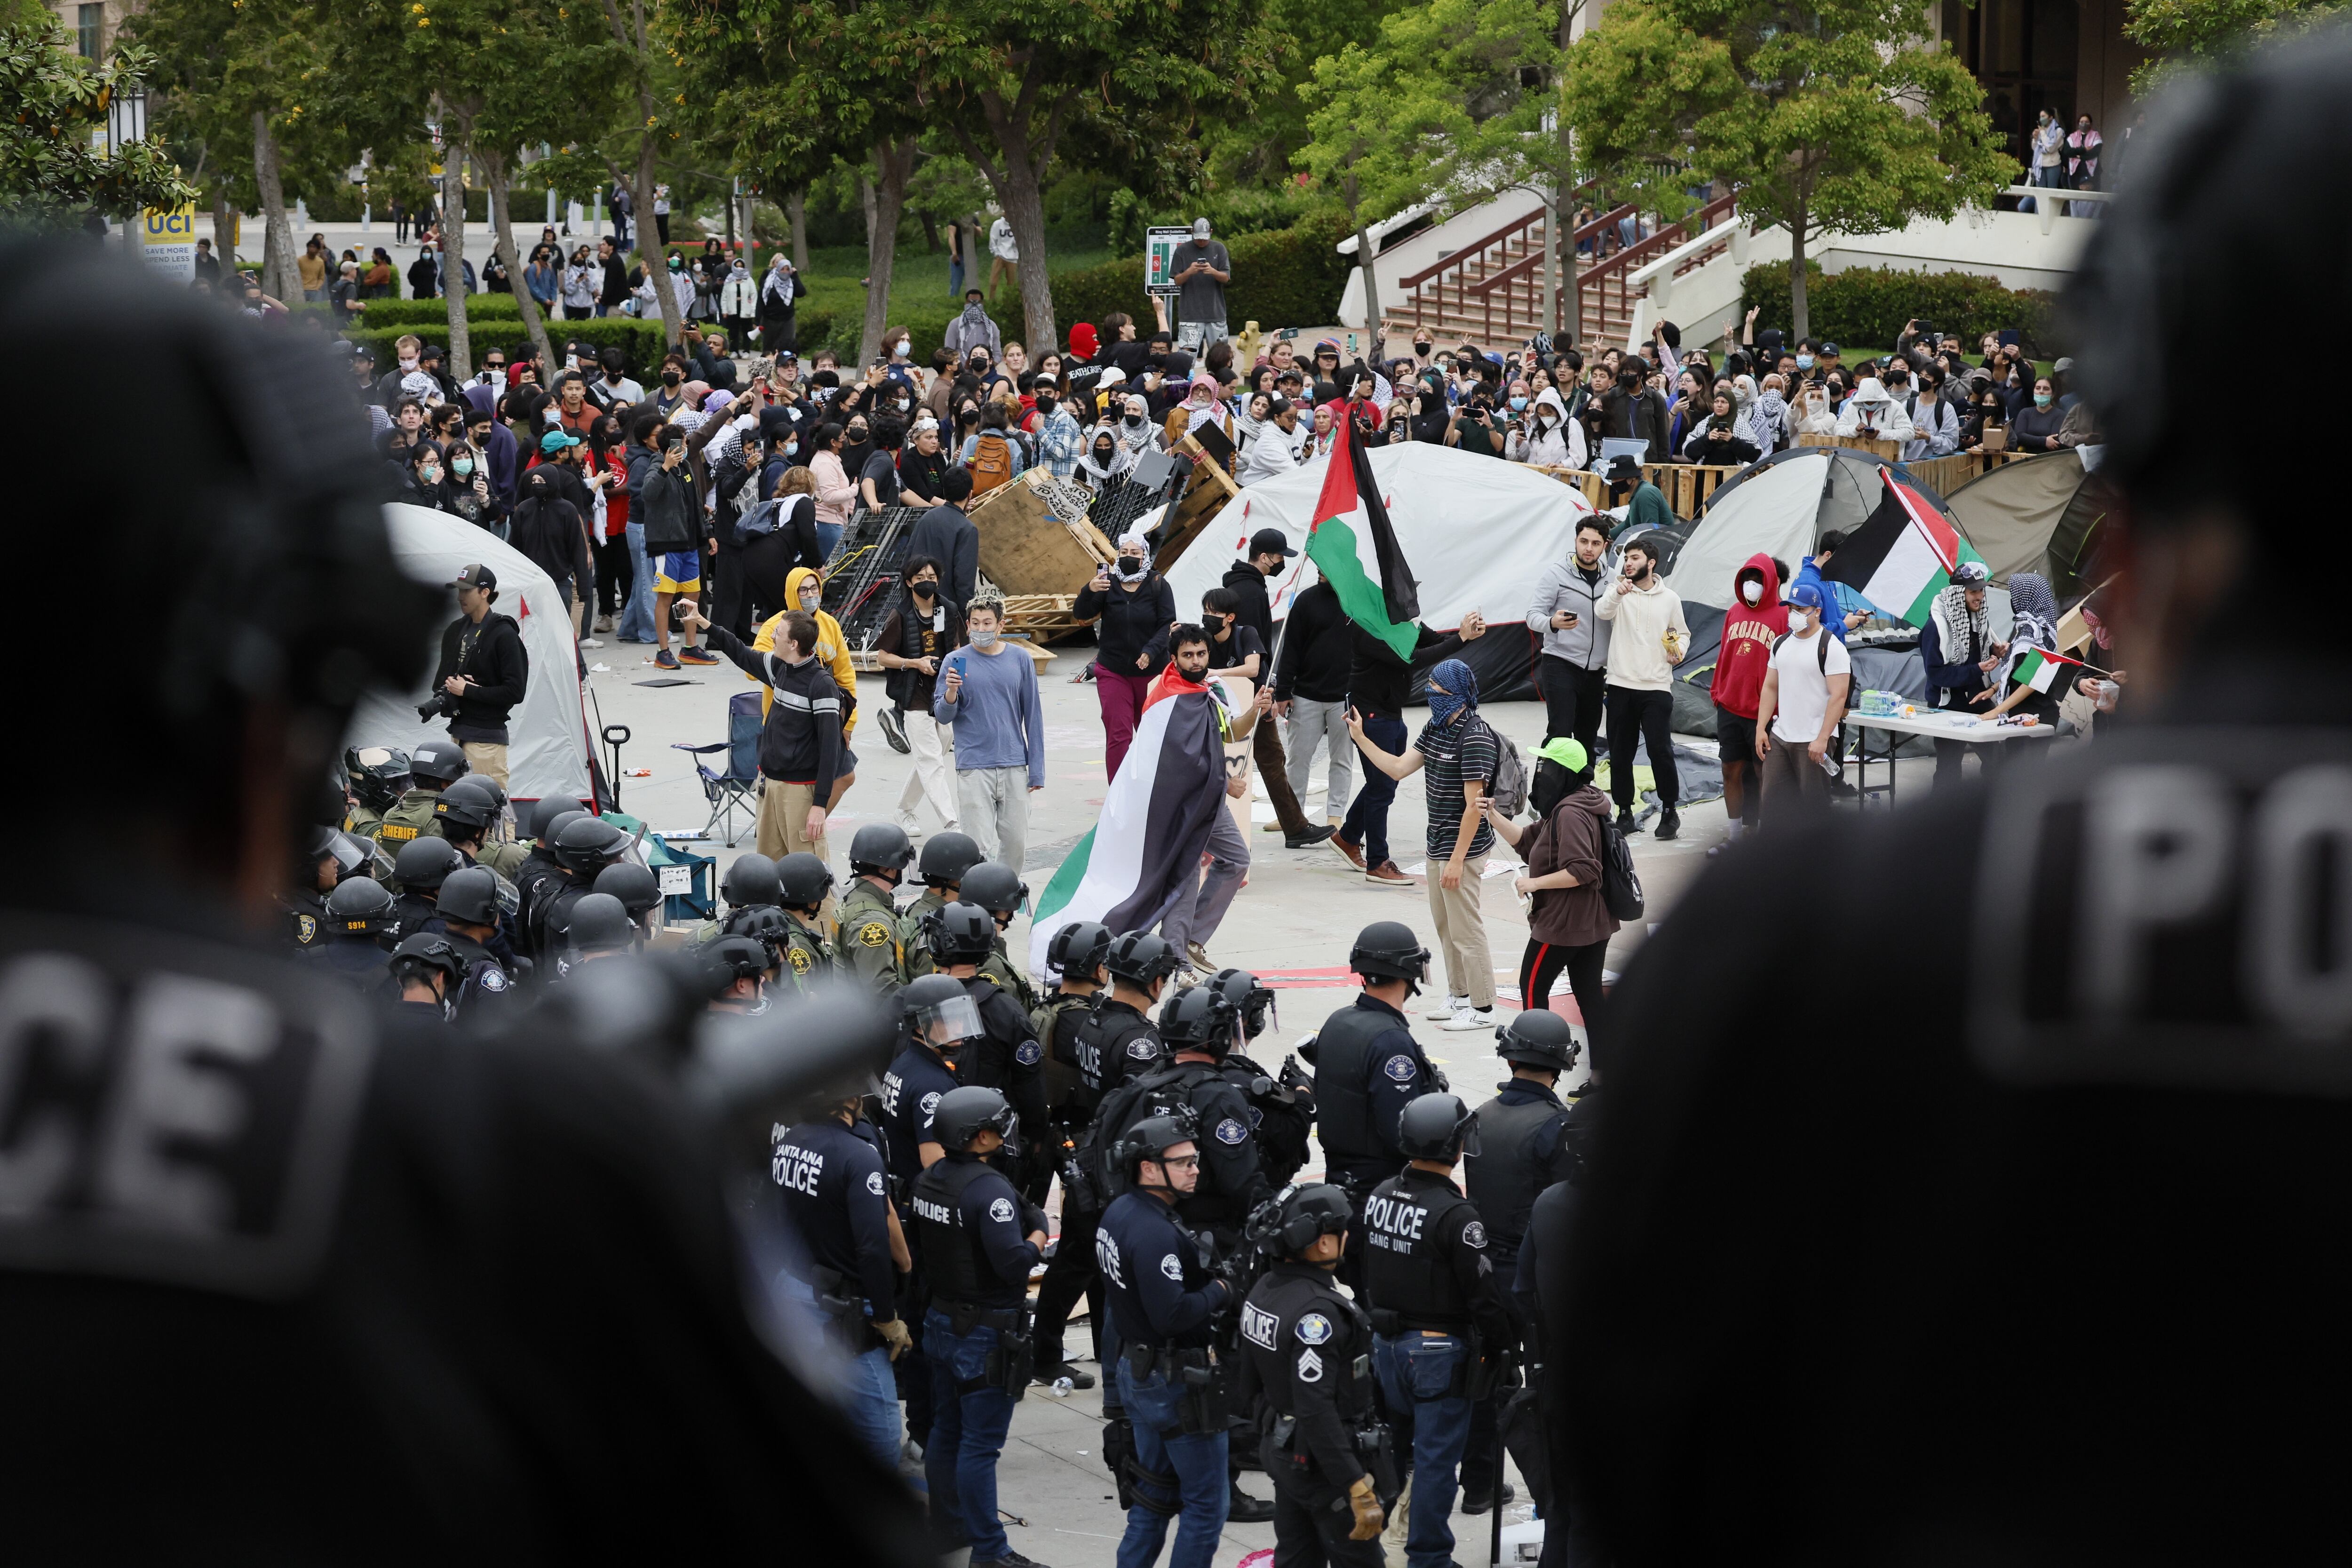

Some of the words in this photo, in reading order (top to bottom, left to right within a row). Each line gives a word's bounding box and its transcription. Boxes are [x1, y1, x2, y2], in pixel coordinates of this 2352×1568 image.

[148, 215, 190, 234] UCI
[1067, 367, 1087, 380] DEATH
[1087, 365, 1103, 374] GRIPS
[1049, 497, 1072, 523] REBEL
[1726, 621, 1775, 650] TROJANS
[382, 824, 418, 840] SHERIFF
[348, 921, 366, 930] S914
[861, 924, 872, 939] ORANGE
[874, 923, 888, 935] COUNTY
[789, 949, 797, 964] RANGE
[483, 971, 494, 980] LAGUNA
[1130, 1039, 1153, 1048] TUSTIN
[1075, 1037, 1102, 1077] POLICE
[923, 1094, 937, 1103] SANTA
[1220, 1120, 1242, 1129] TUSTIN
[775, 1144, 800, 1159] SANTA
[800, 1150, 823, 1169] ANA
[772, 1157, 821, 1197] POLICE
[1397, 1191, 1412, 1200] GOMEZ
[913, 1196, 950, 1224] POLICE
[993, 1200, 1004, 1211] SANTA
[1364, 1195, 1428, 1240] POLICE
[1369, 1231, 1389, 1249] GANG
[1392, 1239, 1412, 1254] UNIT
[1096, 1241, 1127, 1289] OLICE
[1243, 1305, 1274, 1345] POLICE
